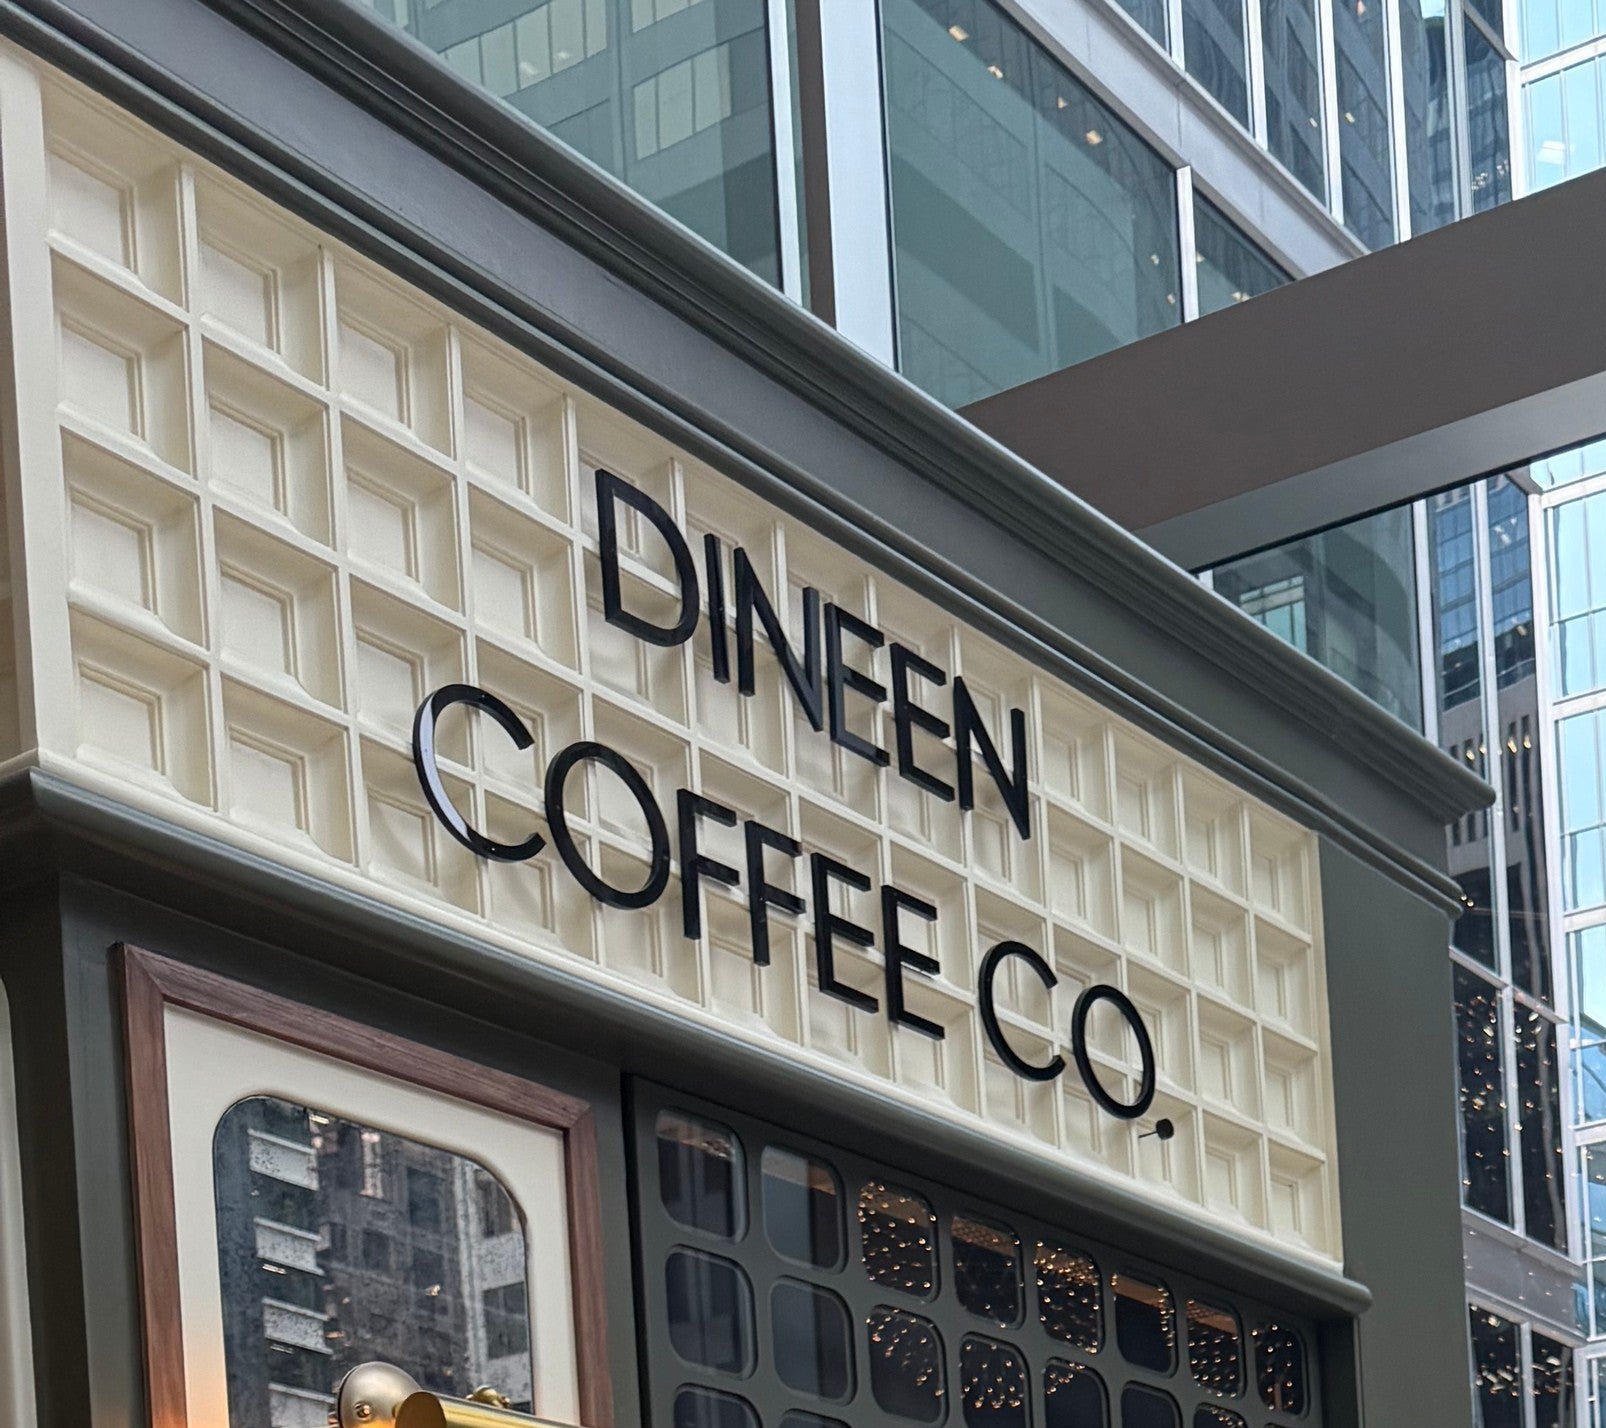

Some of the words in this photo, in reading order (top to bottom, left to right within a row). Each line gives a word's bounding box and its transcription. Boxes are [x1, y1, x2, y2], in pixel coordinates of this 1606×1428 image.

[595, 469, 1032, 841] DINEEN
[413, 683, 945, 1041] COFFEE
[978, 940, 1175, 1140] CO.
